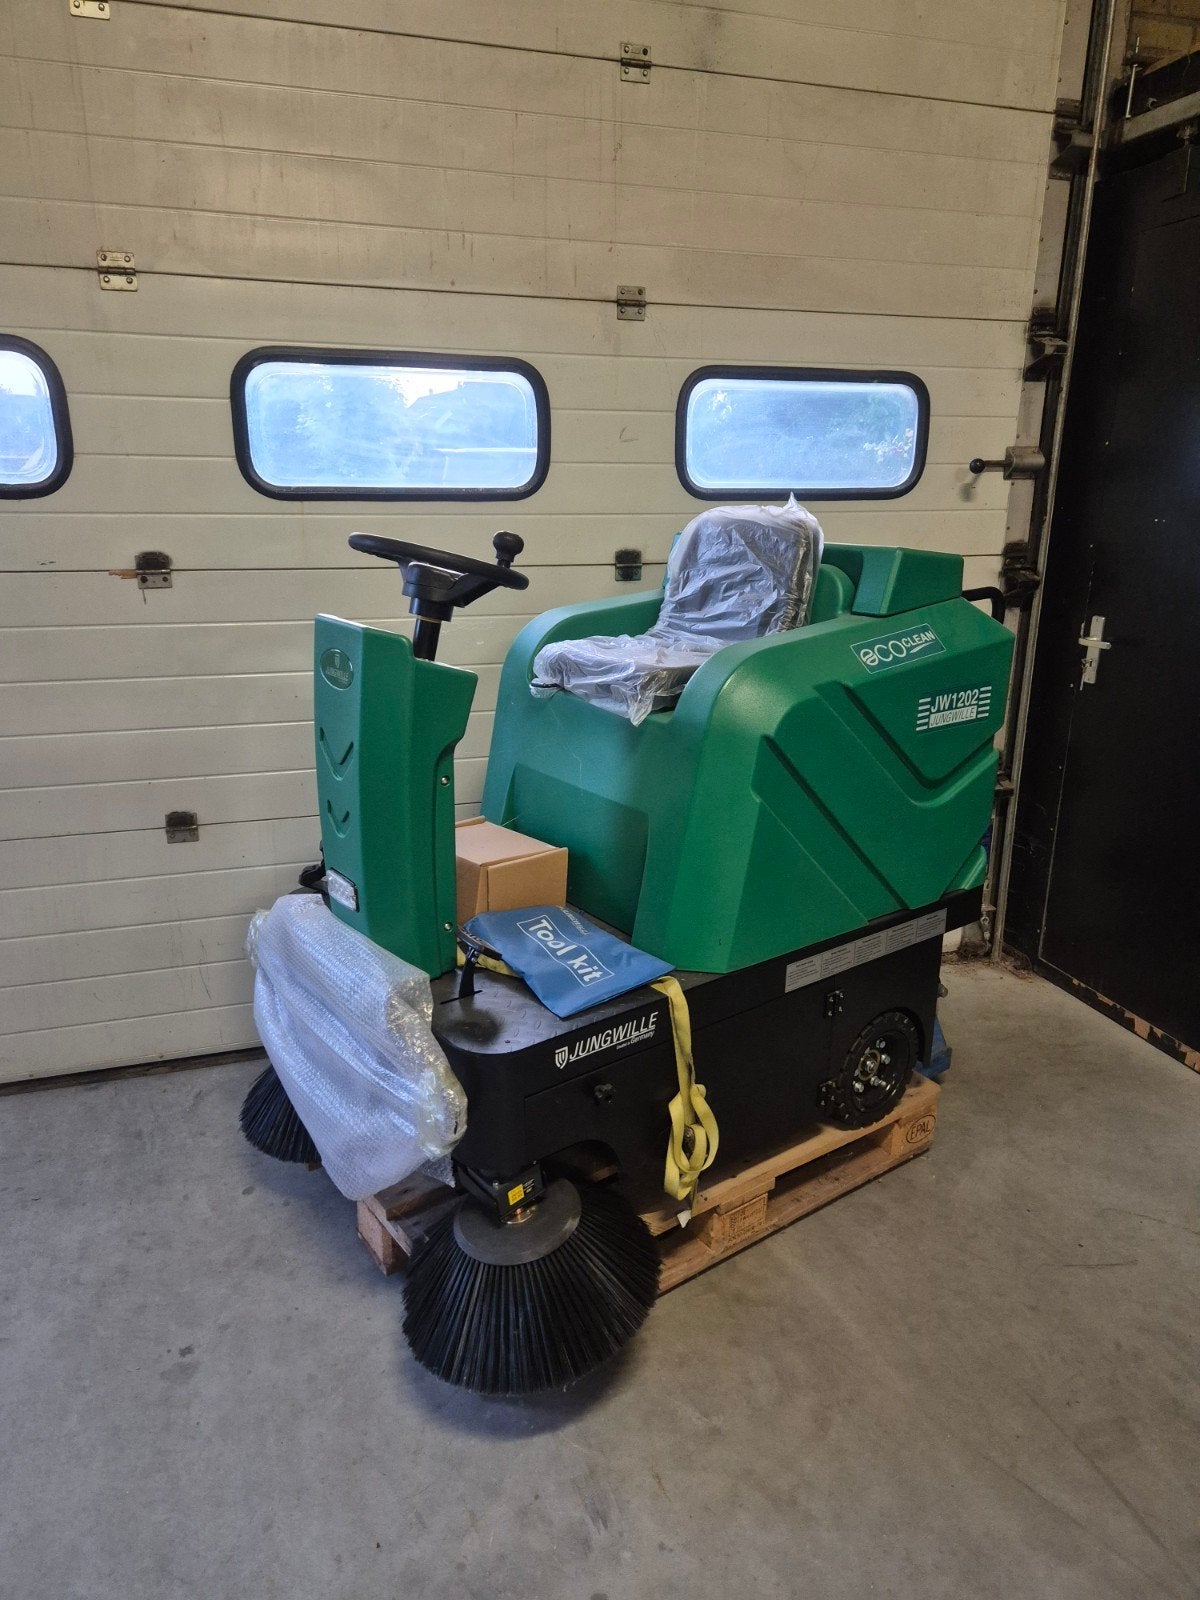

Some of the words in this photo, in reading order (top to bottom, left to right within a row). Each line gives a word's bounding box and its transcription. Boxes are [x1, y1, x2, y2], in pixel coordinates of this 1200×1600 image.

[901, 630, 936, 648] CLEAN
[930, 689, 979, 713] JW1202
[930, 707, 976, 727] JUNGWILLE
[528, 919, 578, 956] Tool
[567, 954, 604, 982] kit
[569, 1011, 659, 1060] JUNGWILLE
[910, 1120, 931, 1141] EPAL
